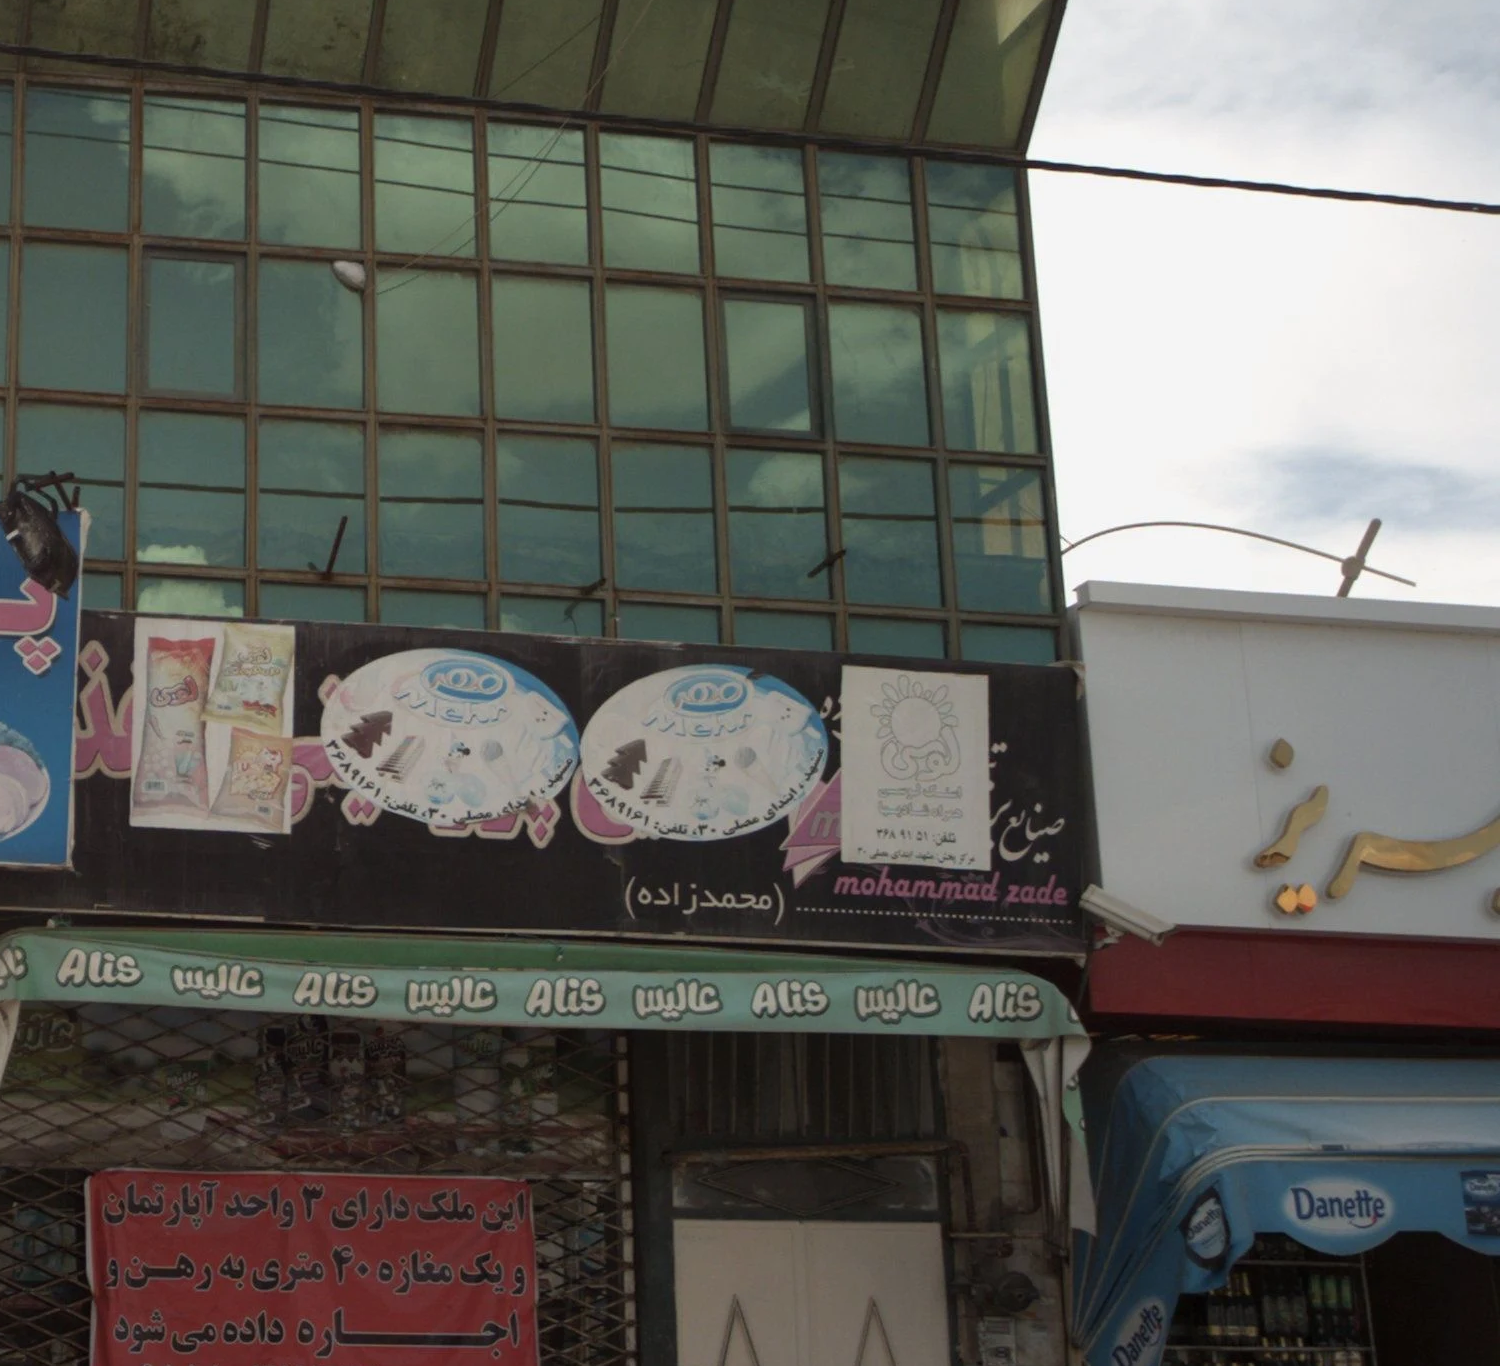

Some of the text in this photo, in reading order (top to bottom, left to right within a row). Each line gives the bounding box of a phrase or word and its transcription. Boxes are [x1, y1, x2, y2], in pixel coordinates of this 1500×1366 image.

[833, 866, 1069, 906] mohammad zade
[56, 947, 143, 986] Alis
[294, 971, 377, 1009] Alis
[524, 977, 605, 1018] Alis
[751, 979, 830, 1020] Alis
[968, 981, 1044, 1023] Alis
[102, 1180, 526, 1232] این ملک دارای ۳ واحد آپارتمان
[1290, 1186, 1385, 1222] Danette
[105, 1257, 119, 1288] و
[219, 1252, 246, 1290] به
[251, 1260, 325, 1291] متری
[330, 1245, 371, 1285] ۴۰
[378, 1252, 453, 1294] مغازه
[460, 1252, 505, 1286] یک
[510, 1265, 526, 1295] و
[114, 1311, 166, 1353] شود
[171, 1326, 221, 1354] می
[222, 1311, 285, 1344] داده
